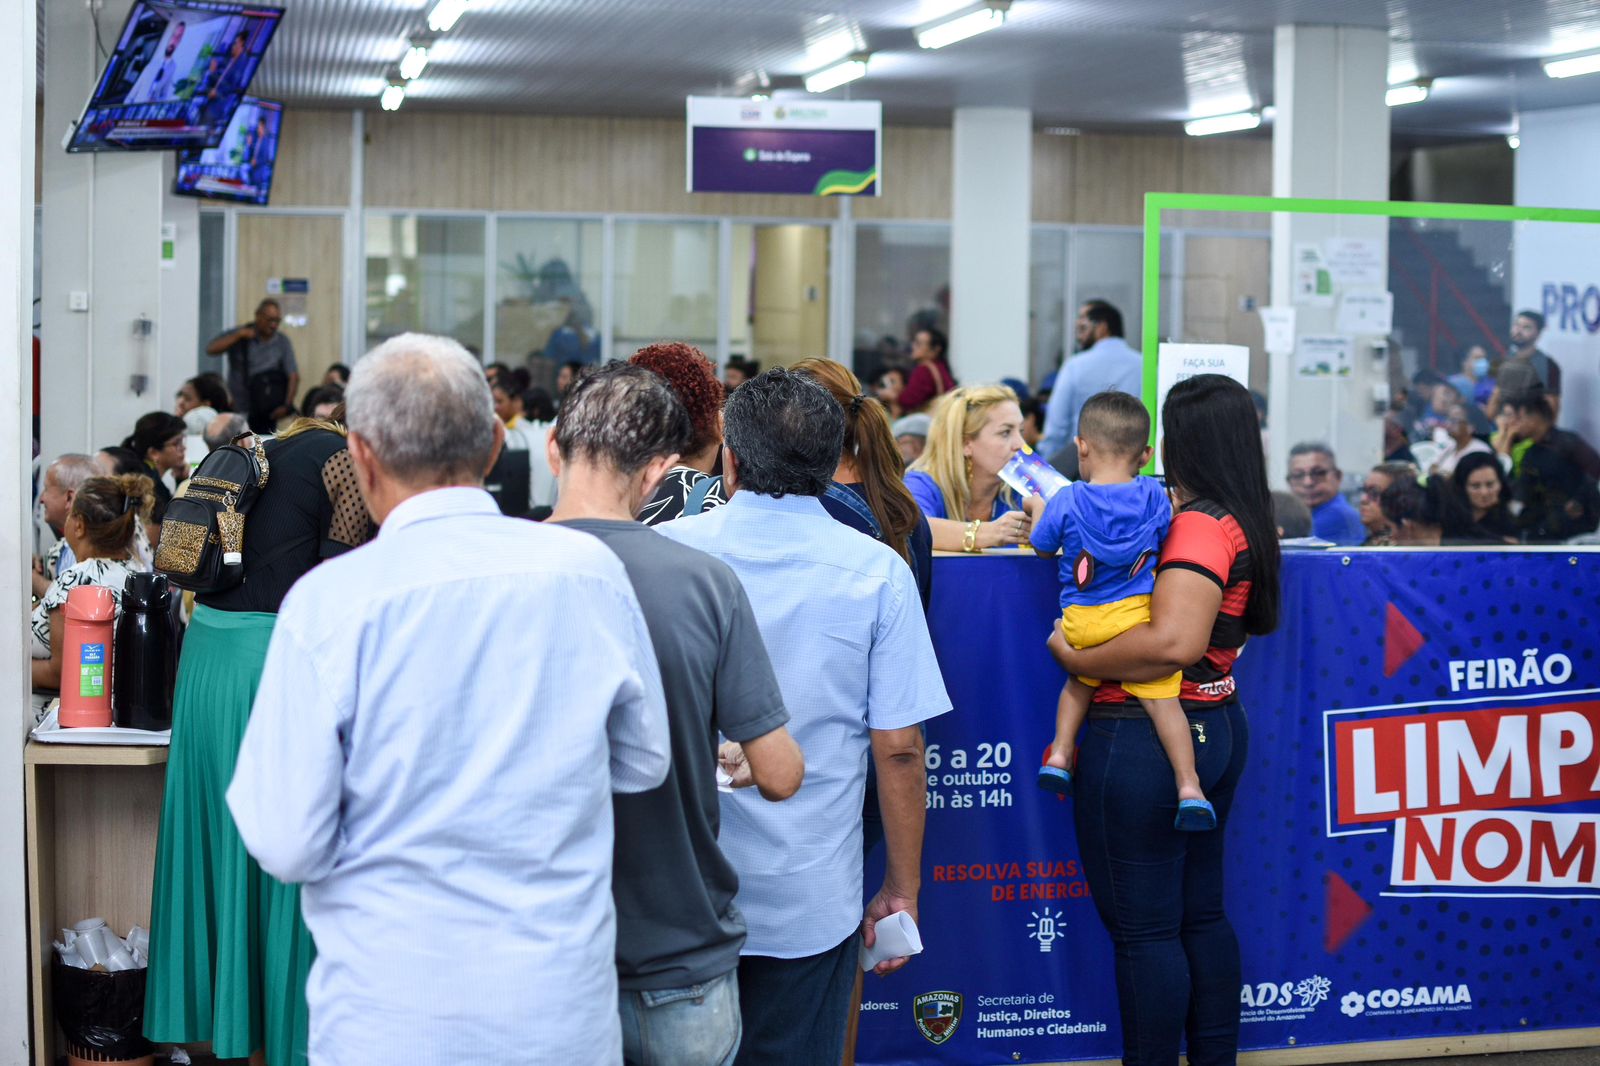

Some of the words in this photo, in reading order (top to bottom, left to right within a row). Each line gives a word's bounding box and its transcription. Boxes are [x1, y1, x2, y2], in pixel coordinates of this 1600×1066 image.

[1542, 283, 1600, 333] PRO
[1183, 358, 1205, 369] FAÇA
[1207, 358, 1225, 367] SUA
[1448, 648, 1573, 692] FEIRÃO
[950, 749, 967, 769] a
[976, 742, 1012, 768] 20
[1351, 711, 1600, 815] LIMP
[925, 771, 938, 786] e
[942, 770, 1012, 786] outubro
[950, 790, 974, 808] às
[979, 788, 1013, 807] 14h
[1402, 817, 1596, 883] NOM
[933, 863, 1022, 881] RESOLVA
[1026, 860, 1078, 879] SUAS
[991, 884, 1015, 902] DE
[1020, 881, 1092, 900] ENERGI
[916, 993, 960, 1006] AMAZONAS
[977, 993, 1036, 1007] Secretaria
[1038, 992, 1054, 1003] de
[1240, 981, 1294, 1007] ADS
[1366, 984, 1472, 1009] COSAMA
[976, 1010, 1022, 1025] Justiça,
[1024, 1007, 1071, 1021] Direitos
[1266, 1006, 1315, 1015] Desenvolvimento
[943, 1017, 959, 1037] Militar
[976, 1026, 1034, 1039] Humanos
[1036, 1026, 1045, 1036] e
[1046, 1021, 1107, 1035] Cidadania
